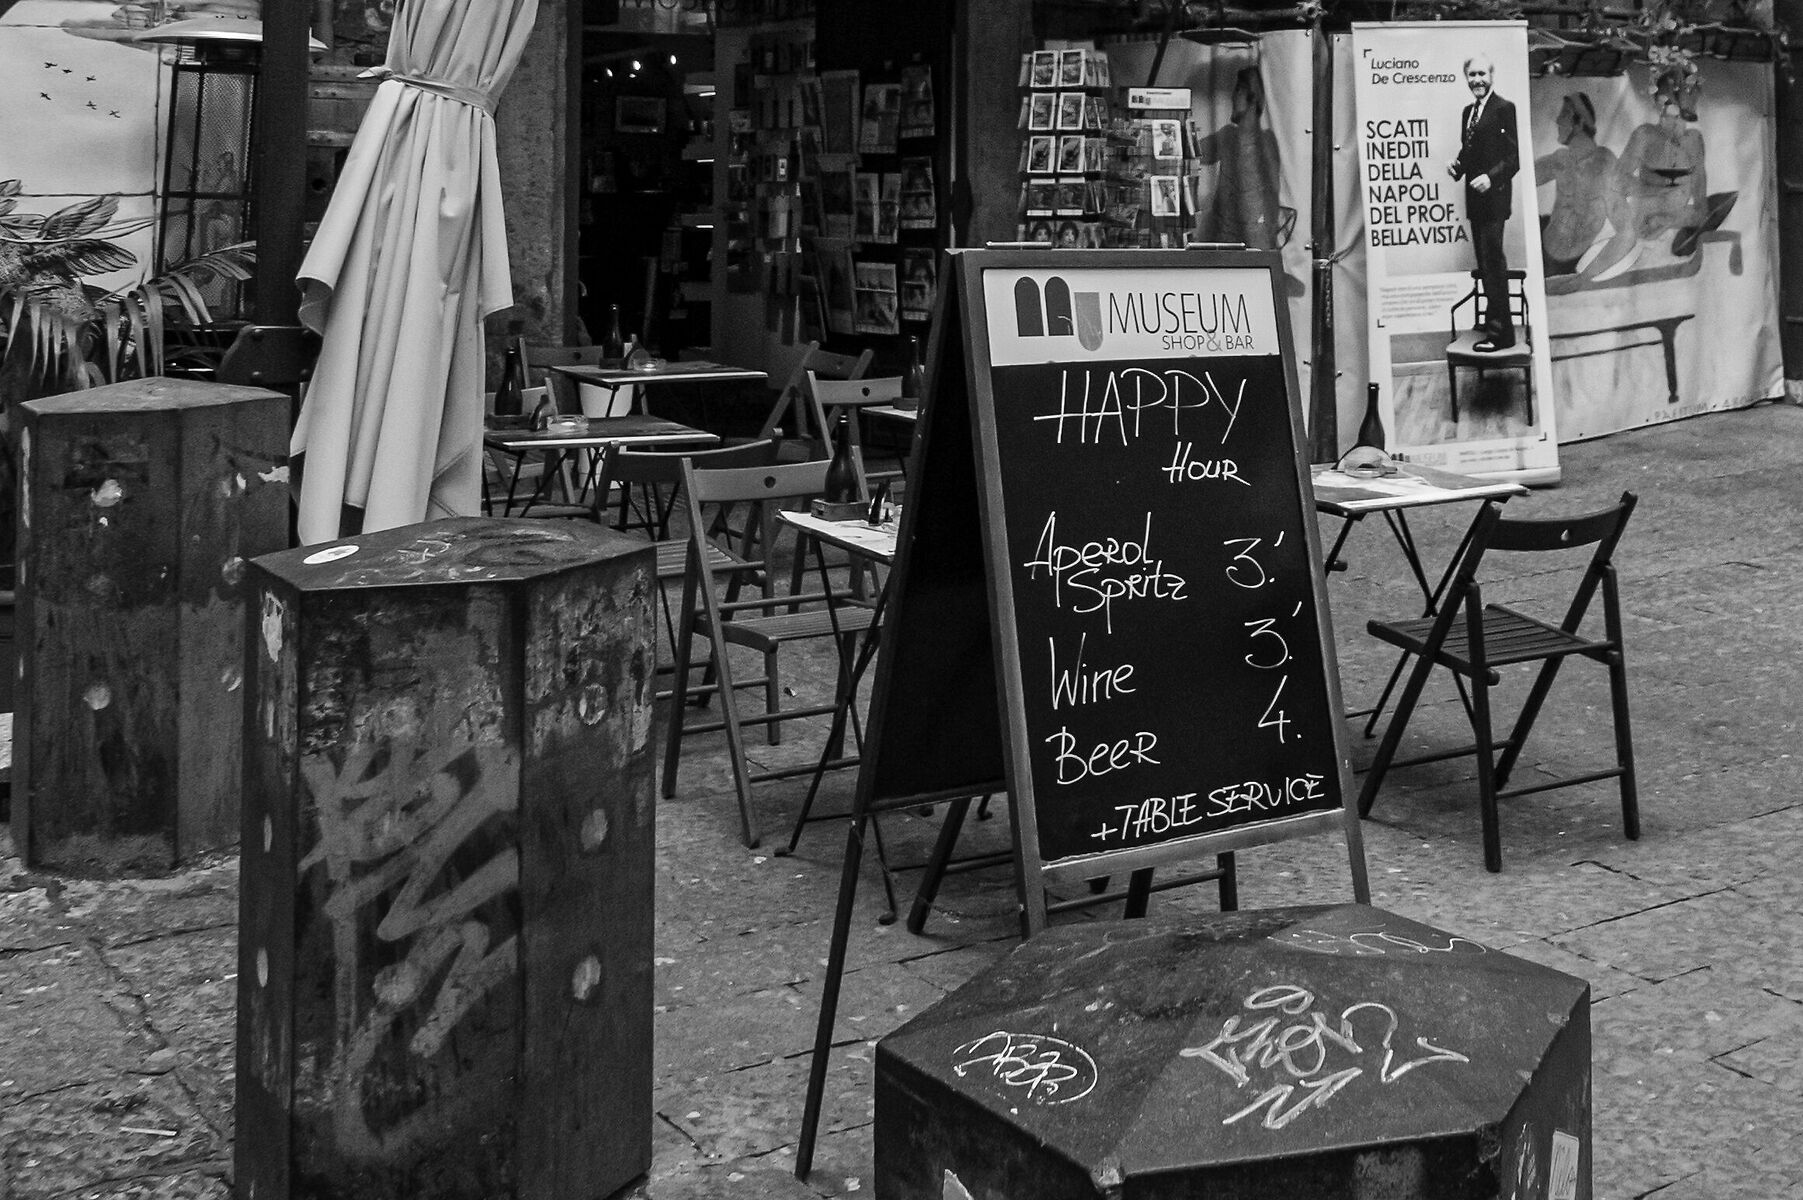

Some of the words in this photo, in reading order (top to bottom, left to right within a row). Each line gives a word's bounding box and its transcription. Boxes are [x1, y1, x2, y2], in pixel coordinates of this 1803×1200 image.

[1371, 57, 1420, 70] Luciano
[1372, 73, 1389, 85] De
[1392, 72, 1456, 85] Crescenzo
[1366, 118, 1428, 139] SCATTI
[1366, 140, 1429, 160] INEDITI
[1368, 162, 1423, 181] DELLA
[1369, 183, 1439, 203] NAPOLI
[1370, 206, 1402, 225] DEL
[1407, 204, 1460, 224] PROF.
[1371, 225, 1469, 247] BELLAVISTA
[1109, 292, 1252, 334] MUSEUM
[1033, 368, 1246, 446] HAPPY
[1048, 632, 1137, 710] Wine
[1206, 773, 1325, 818] SERVICE
